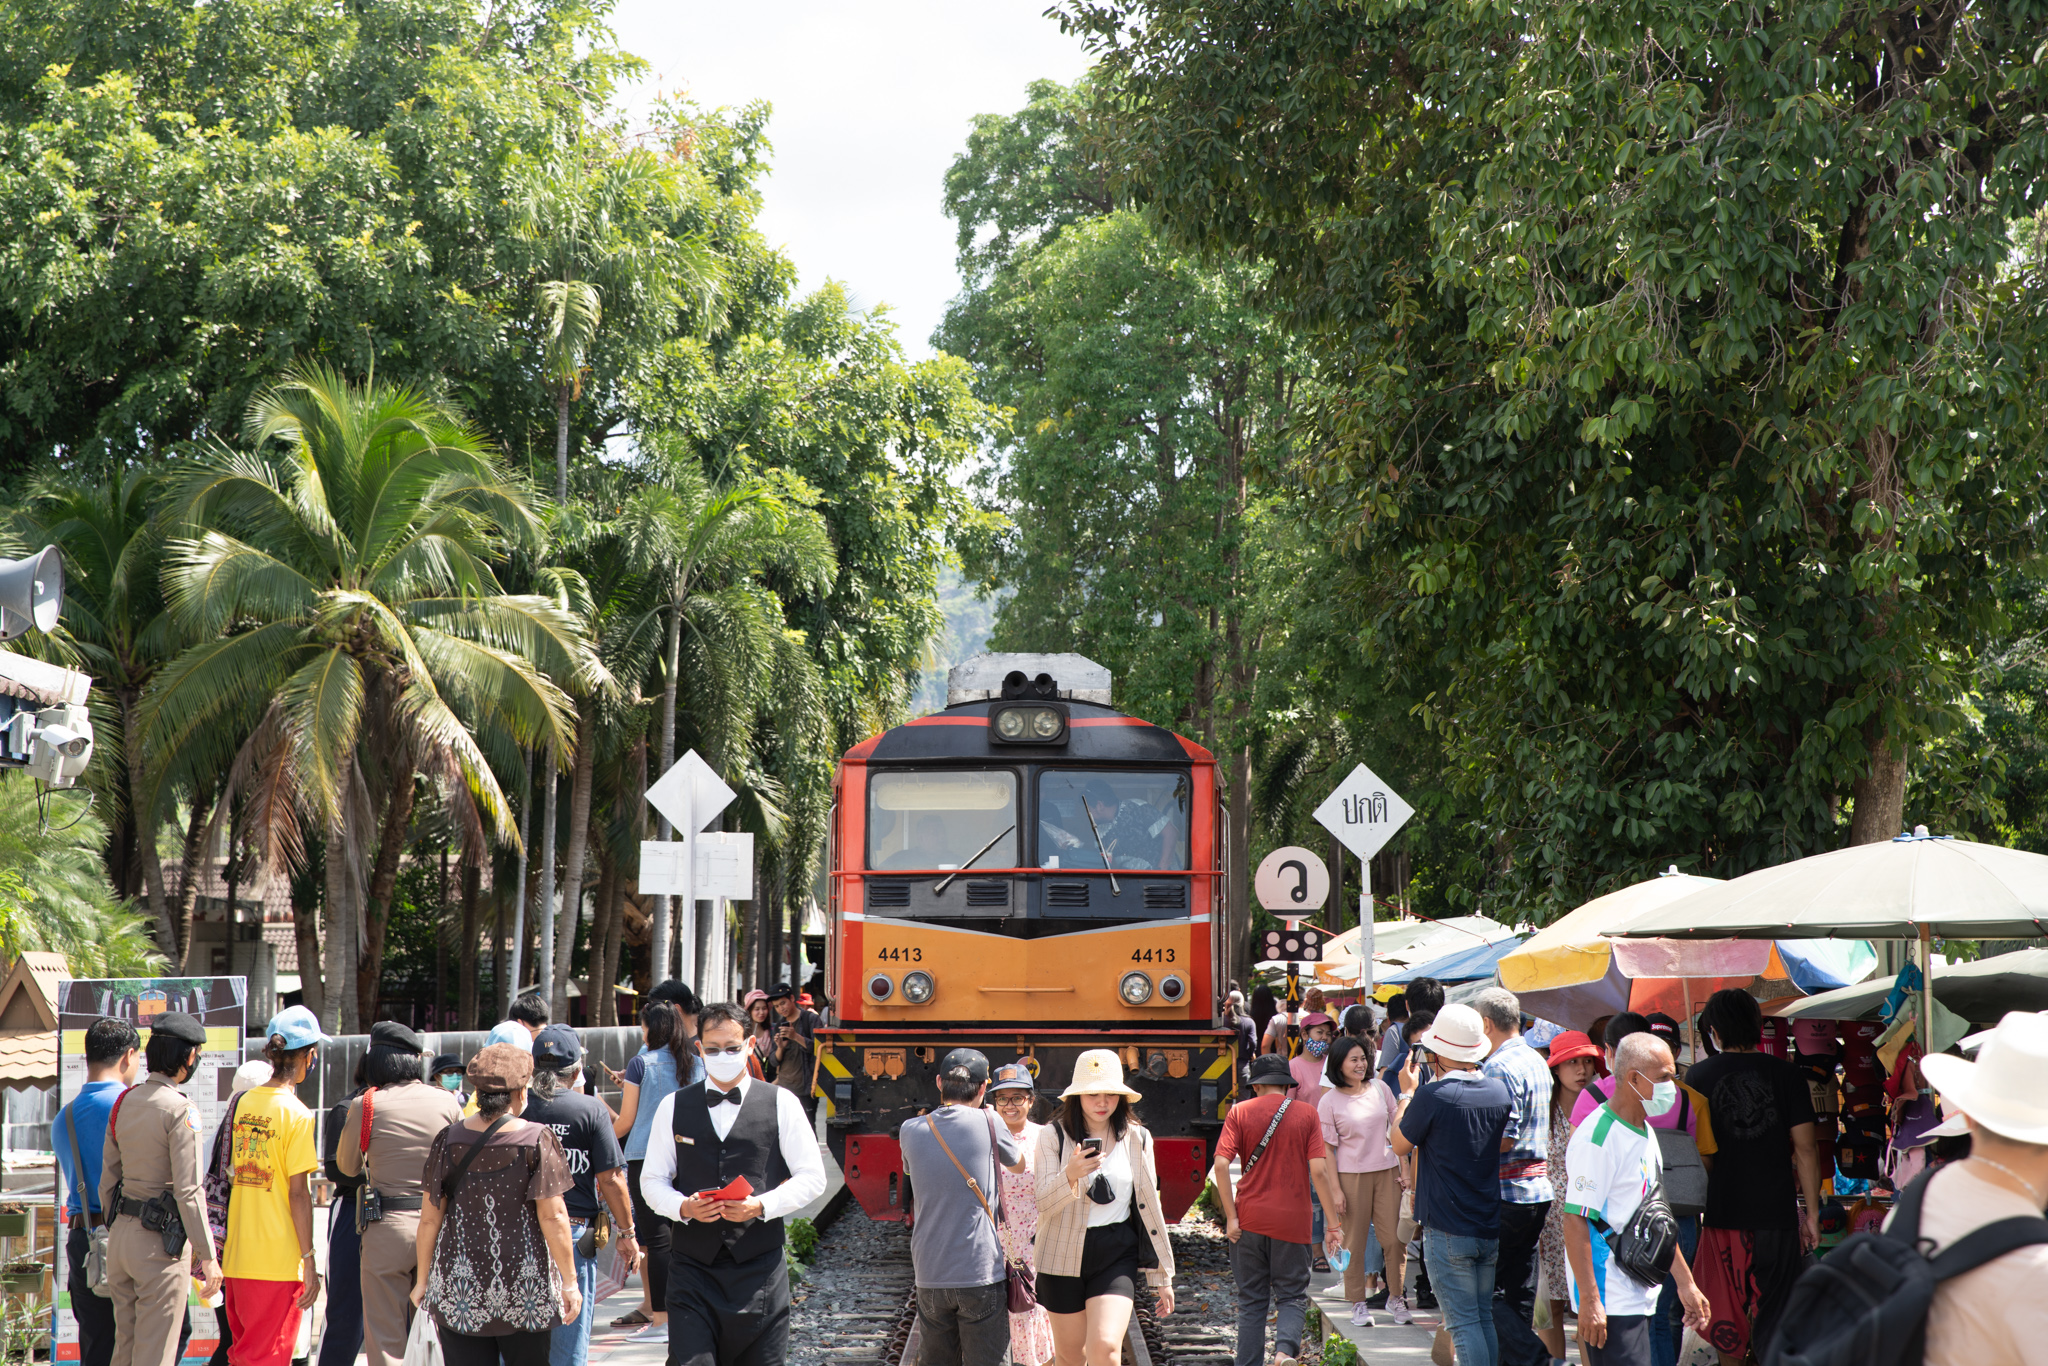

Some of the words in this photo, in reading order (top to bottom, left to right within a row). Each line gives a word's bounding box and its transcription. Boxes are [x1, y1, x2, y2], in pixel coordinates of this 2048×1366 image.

[1342, 791, 1388, 824] ปกติ
[1277, 859, 1308, 903] ว
[878, 947, 922, 962] 4413
[1131, 948, 1175, 963] 4413
[1651, 1023, 1673, 1032] Supreme
